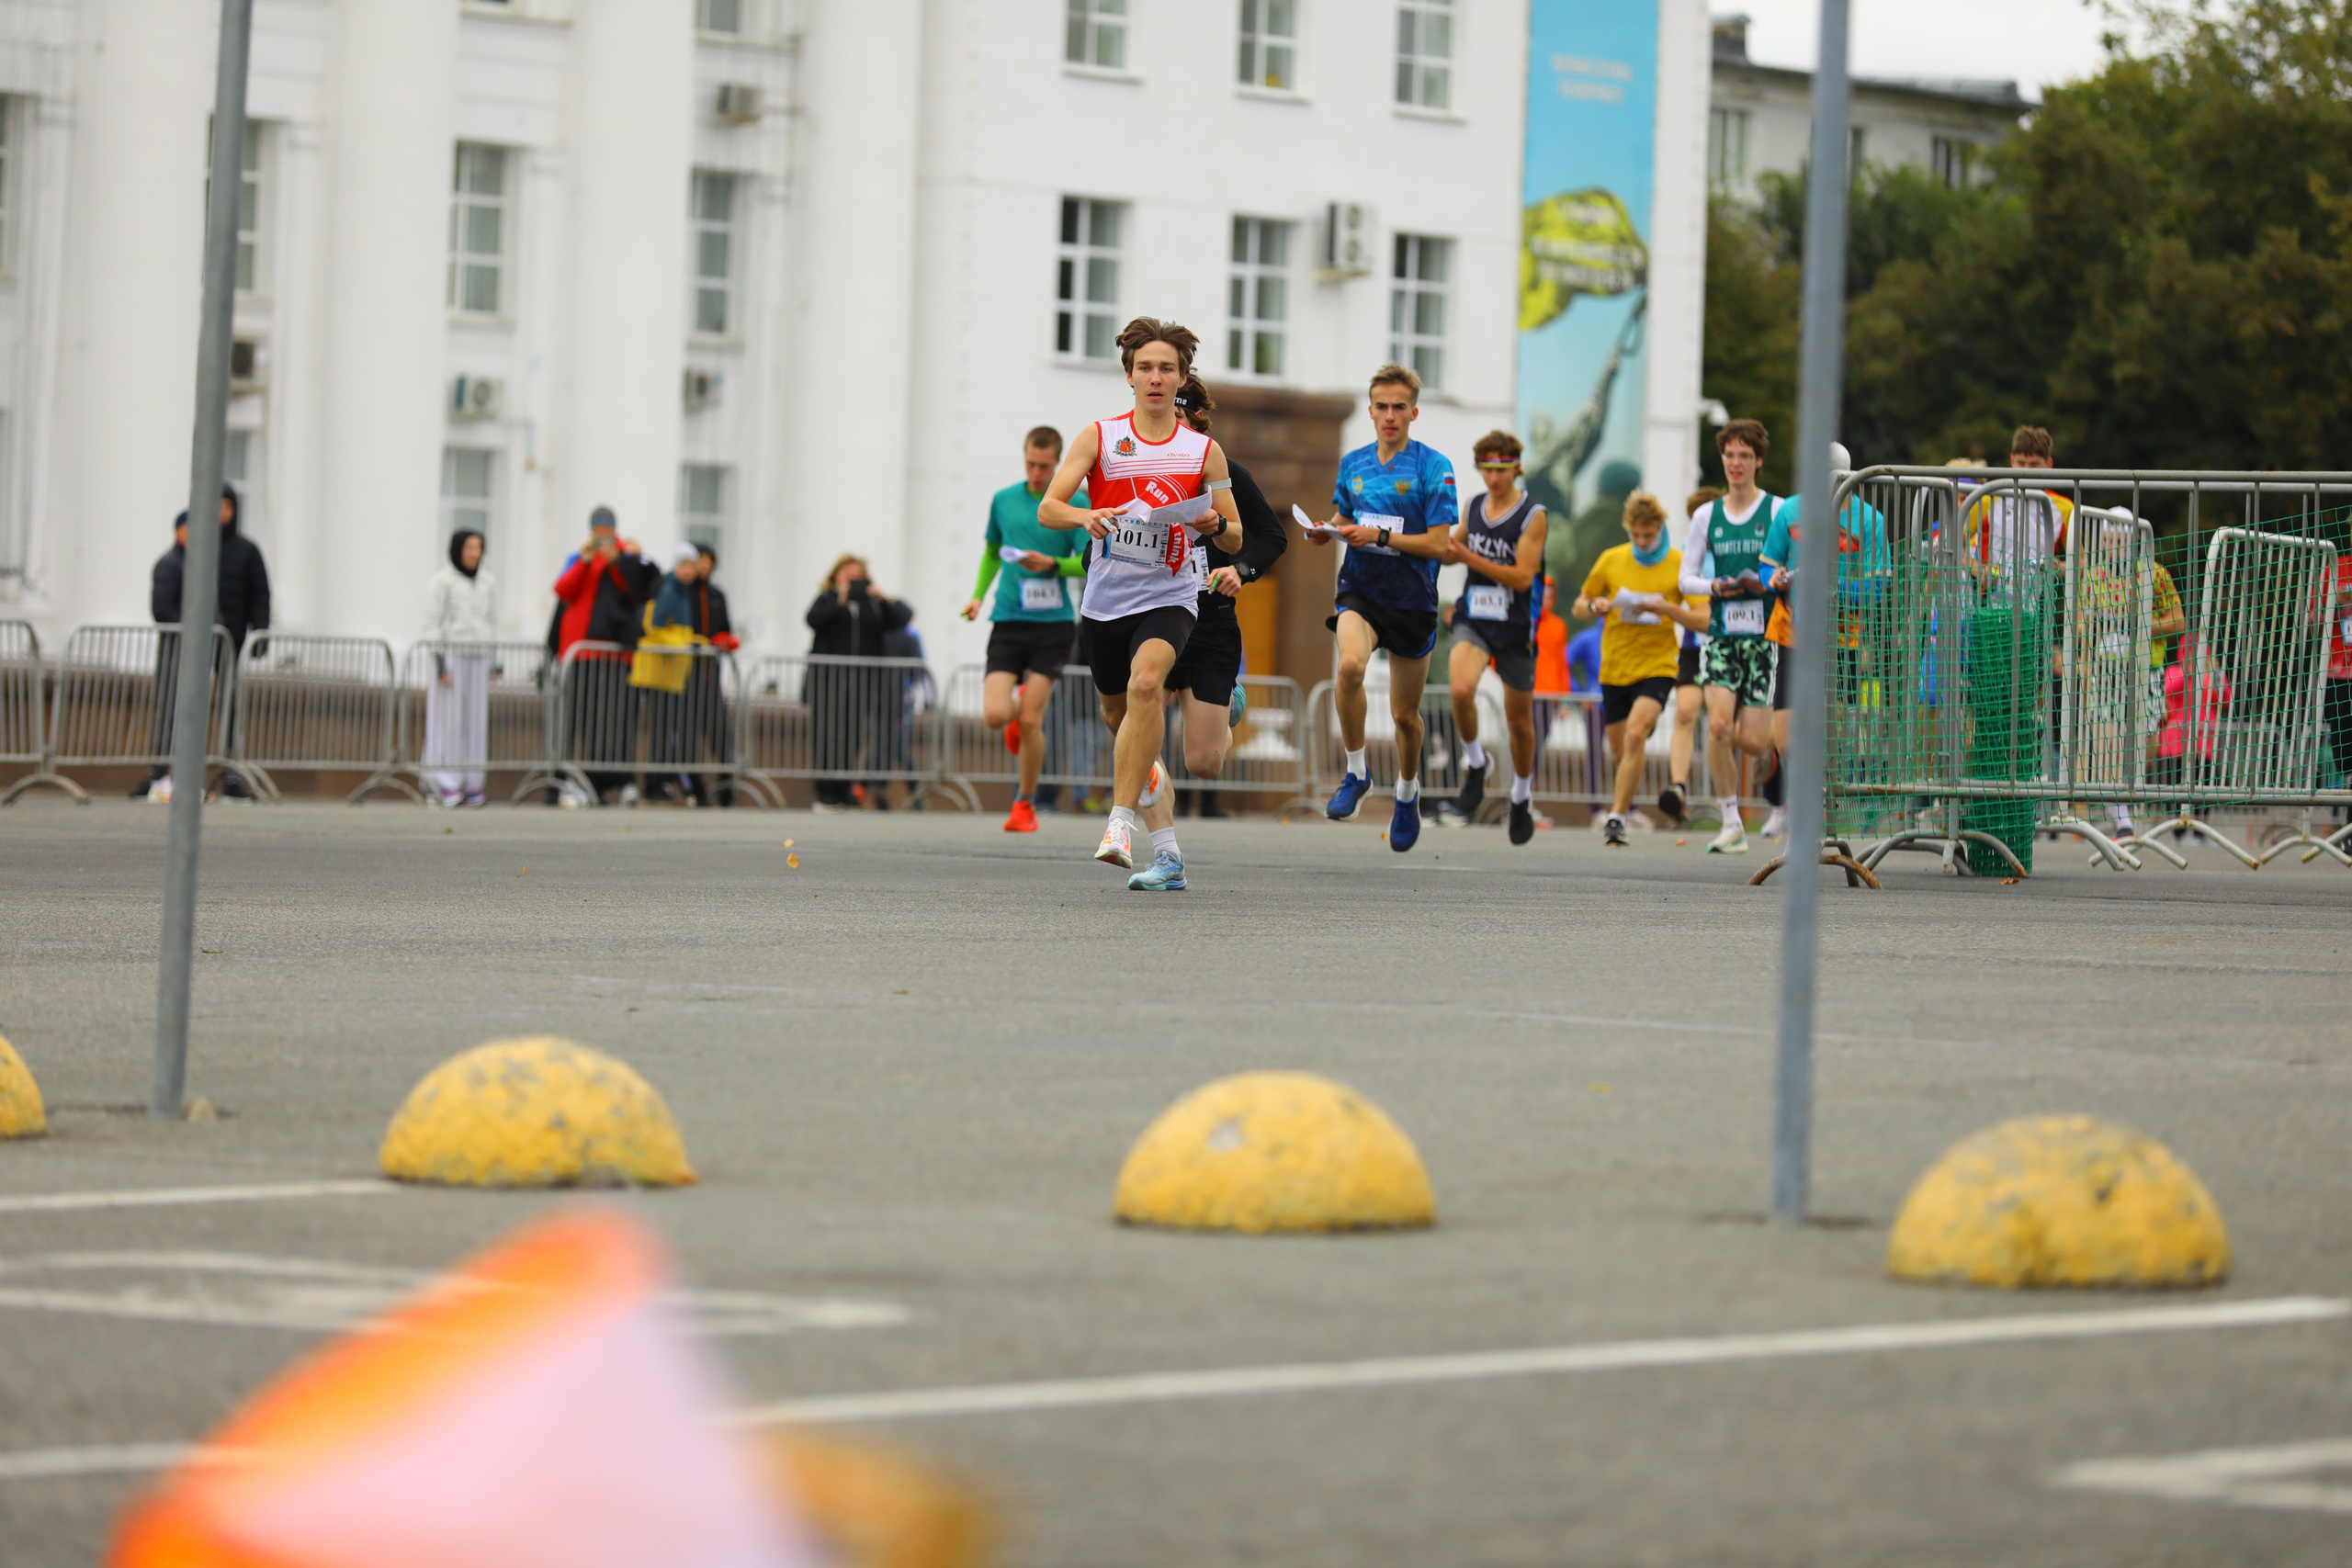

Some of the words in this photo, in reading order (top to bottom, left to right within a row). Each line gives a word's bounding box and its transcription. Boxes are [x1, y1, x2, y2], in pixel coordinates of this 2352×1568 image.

[1145, 480, 1170, 504] Run
[1114, 528, 1158, 548] 101.1
[1167, 532, 1182, 563] think
[1727, 608, 1755, 622] 109.1
